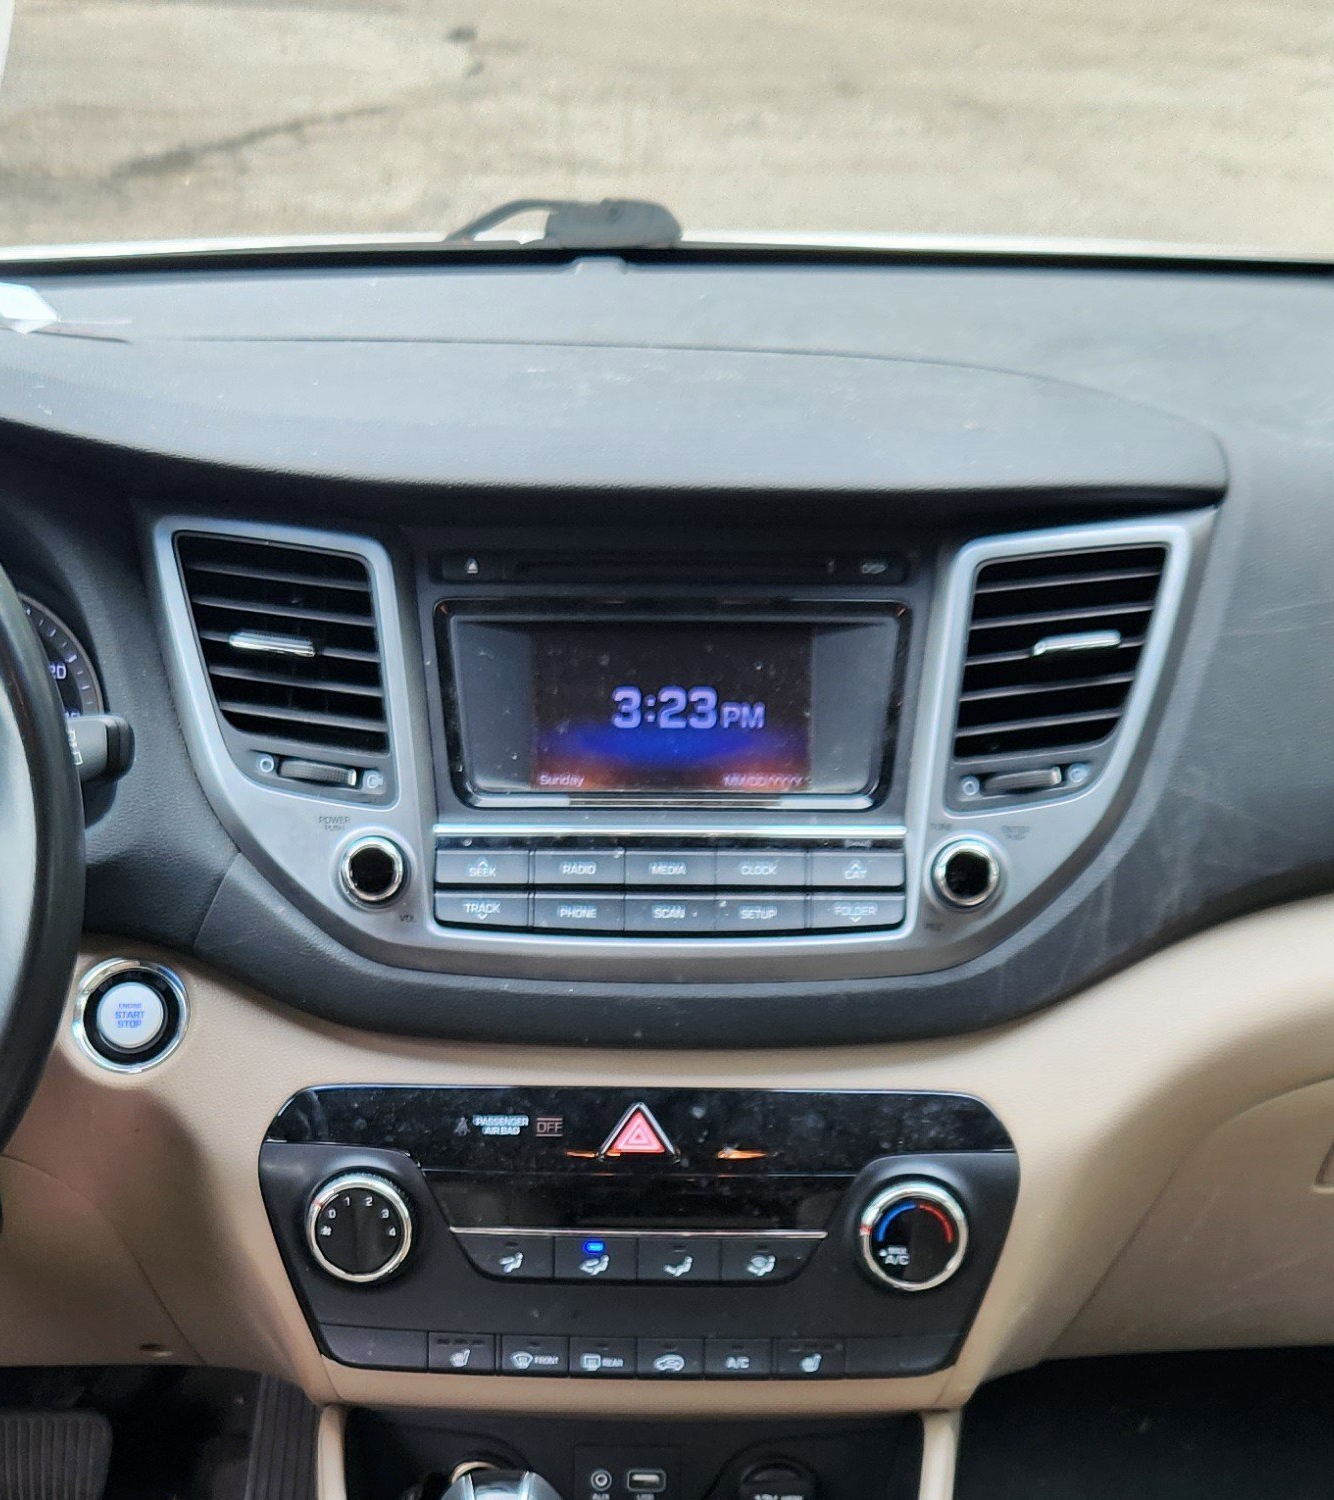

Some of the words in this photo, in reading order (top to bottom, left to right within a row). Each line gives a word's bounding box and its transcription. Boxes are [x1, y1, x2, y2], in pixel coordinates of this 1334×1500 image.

[613, 685, 717, 729] 3:23
[721, 702, 765, 729] PM
[540, 773, 584, 788] Sunday
[469, 867, 497, 877] SEEK
[560, 862, 597, 875] RADIO
[650, 863, 686, 875] MEDIA
[740, 862, 777, 876] CLOCK
[845, 870, 867, 880] CAT
[464, 903, 501, 914] TRACK
[558, 905, 597, 919] PHONE
[652, 905, 686, 919] SCAN
[740, 907, 777, 920] SETUP
[833, 903, 877, 916] FOLDER
[115, 1011, 145, 1020] START
[117, 1020, 142, 1029] STOP
[473, 1115, 529, 1127] PASSENGER
[536, 1121, 563, 1133] OFF
[344, 1197, 350, 1207] 1
[365, 1197, 373, 1207] 2
[381, 1209, 389, 1219] 3
[389, 1227, 396, 1237] 4
[885, 1255, 909, 1265] A/C
[726, 1356, 750, 1369] A/C
[592, 1493, 610, 1500] AUX
